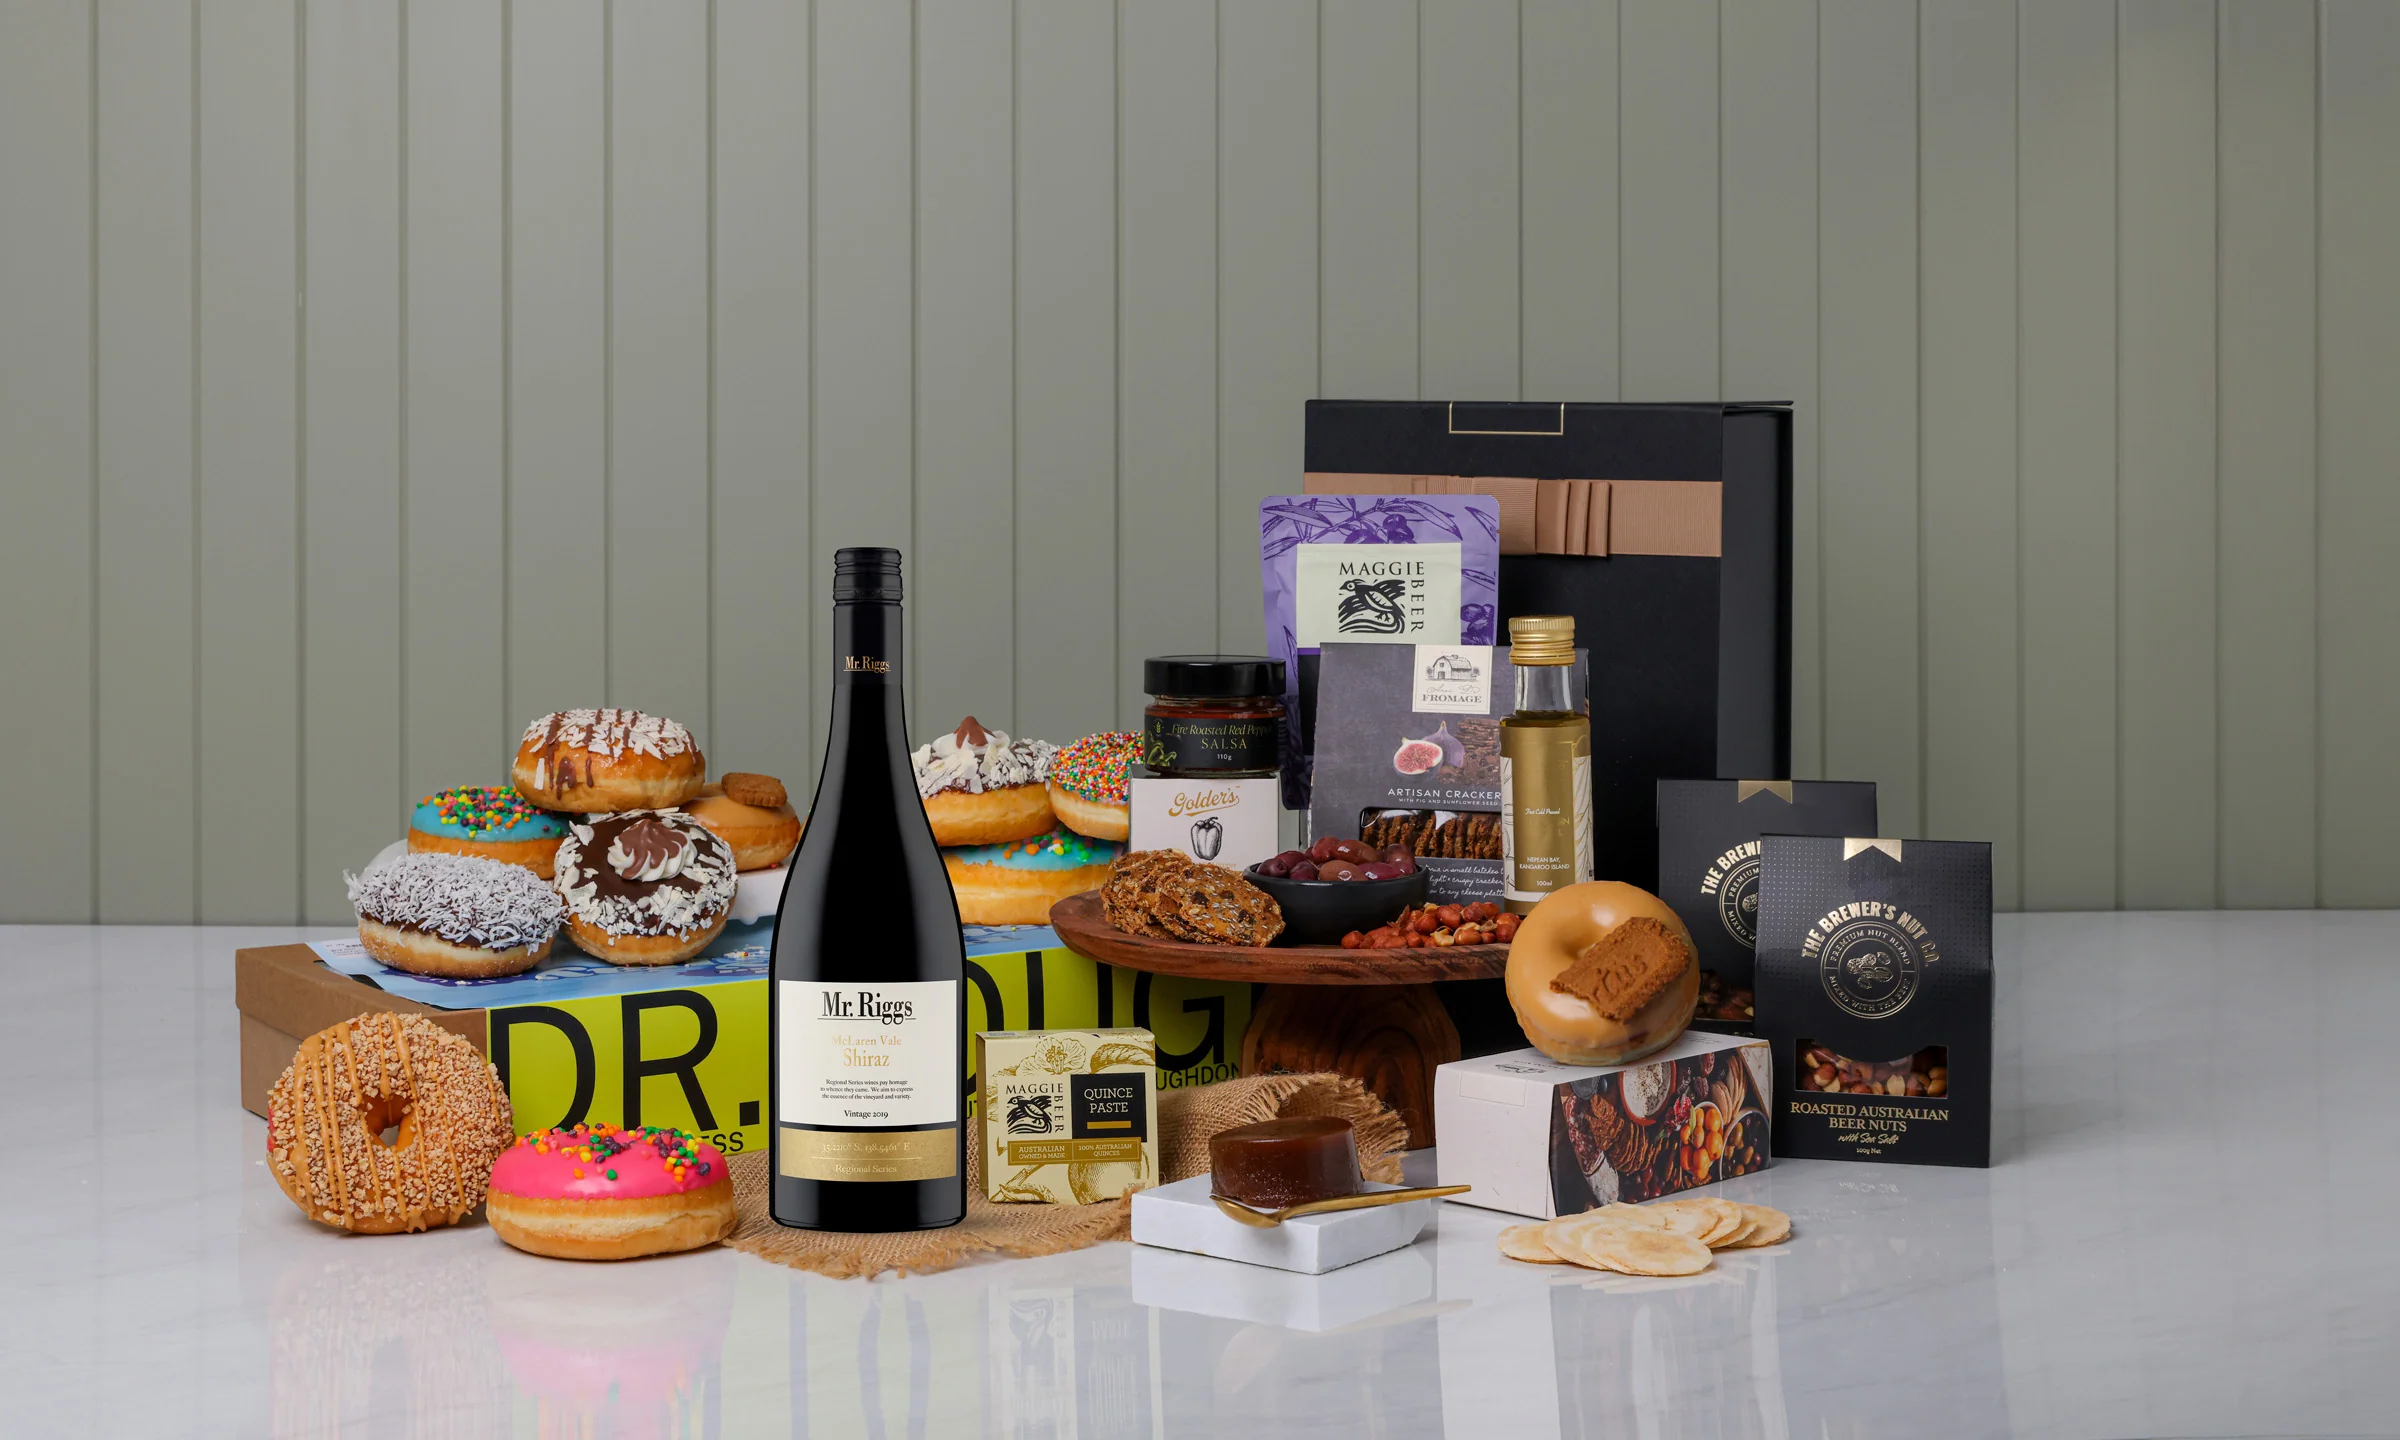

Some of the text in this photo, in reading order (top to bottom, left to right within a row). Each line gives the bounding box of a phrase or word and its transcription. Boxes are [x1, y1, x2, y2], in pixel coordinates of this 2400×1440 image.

[1339, 561, 1425, 576] MAGGIE
[1410, 579, 1425, 633] BEER
[845, 655, 890, 673] Mr. Riggs
[1422, 694, 1482, 704] FROMAGE
[1171, 723, 1188, 735] Fire
[1190, 724, 1228, 736] Roasted
[1228, 724, 1245, 736] Red
[1201, 738, 1247, 750] SALSA
[1217, 753, 1232, 761] 110g
[1388, 788, 1440, 798] ARTISAN
[1168, 788, 1239, 817] Golder's
[1450, 866, 1472, 874] small
[1473, 866, 1499, 875] batches
[1429, 875, 1447, 886] light
[1451, 876, 1474, 887] crispy
[1701, 867, 1724, 895] THE
[1729, 867, 1760, 897] PREMIUM
[1461, 887, 1484, 896] cheese
[1728, 910, 1747, 936] MIXED
[1801, 928, 1826, 959] THE
[1818, 901, 1897, 933] BREWER'S
[1897, 911, 1928, 939] NUT
[1830, 929, 1911, 965] PREMIUM NUT BLEND
[822, 991, 913, 1025] Mr. Riggs
[832, 1035, 902, 1046] McLaren Vale
[490, 989, 760, 1132] DR.
[843, 1048, 890, 1067] Shiraz
[1006, 1083, 1064, 1095] MAGGIE
[1083, 1087, 1133, 1100] QUINCE
[844, 1110, 889, 1119] Vintage 2019
[1054, 1095, 1065, 1133] BEER
[1089, 1102, 1129, 1114] PASTE
[1791, 1102, 1949, 1121] ROASTED AUSTRALIAN
[1829, 1117, 1907, 1132] BEER NUTS
[1838, 1132, 1899, 1145] with Sea Salt
[903, 1142, 910, 1151] E
[1018, 1145, 1065, 1153] AUSTRALIAN
[835, 1164, 897, 1175] Regional Series
